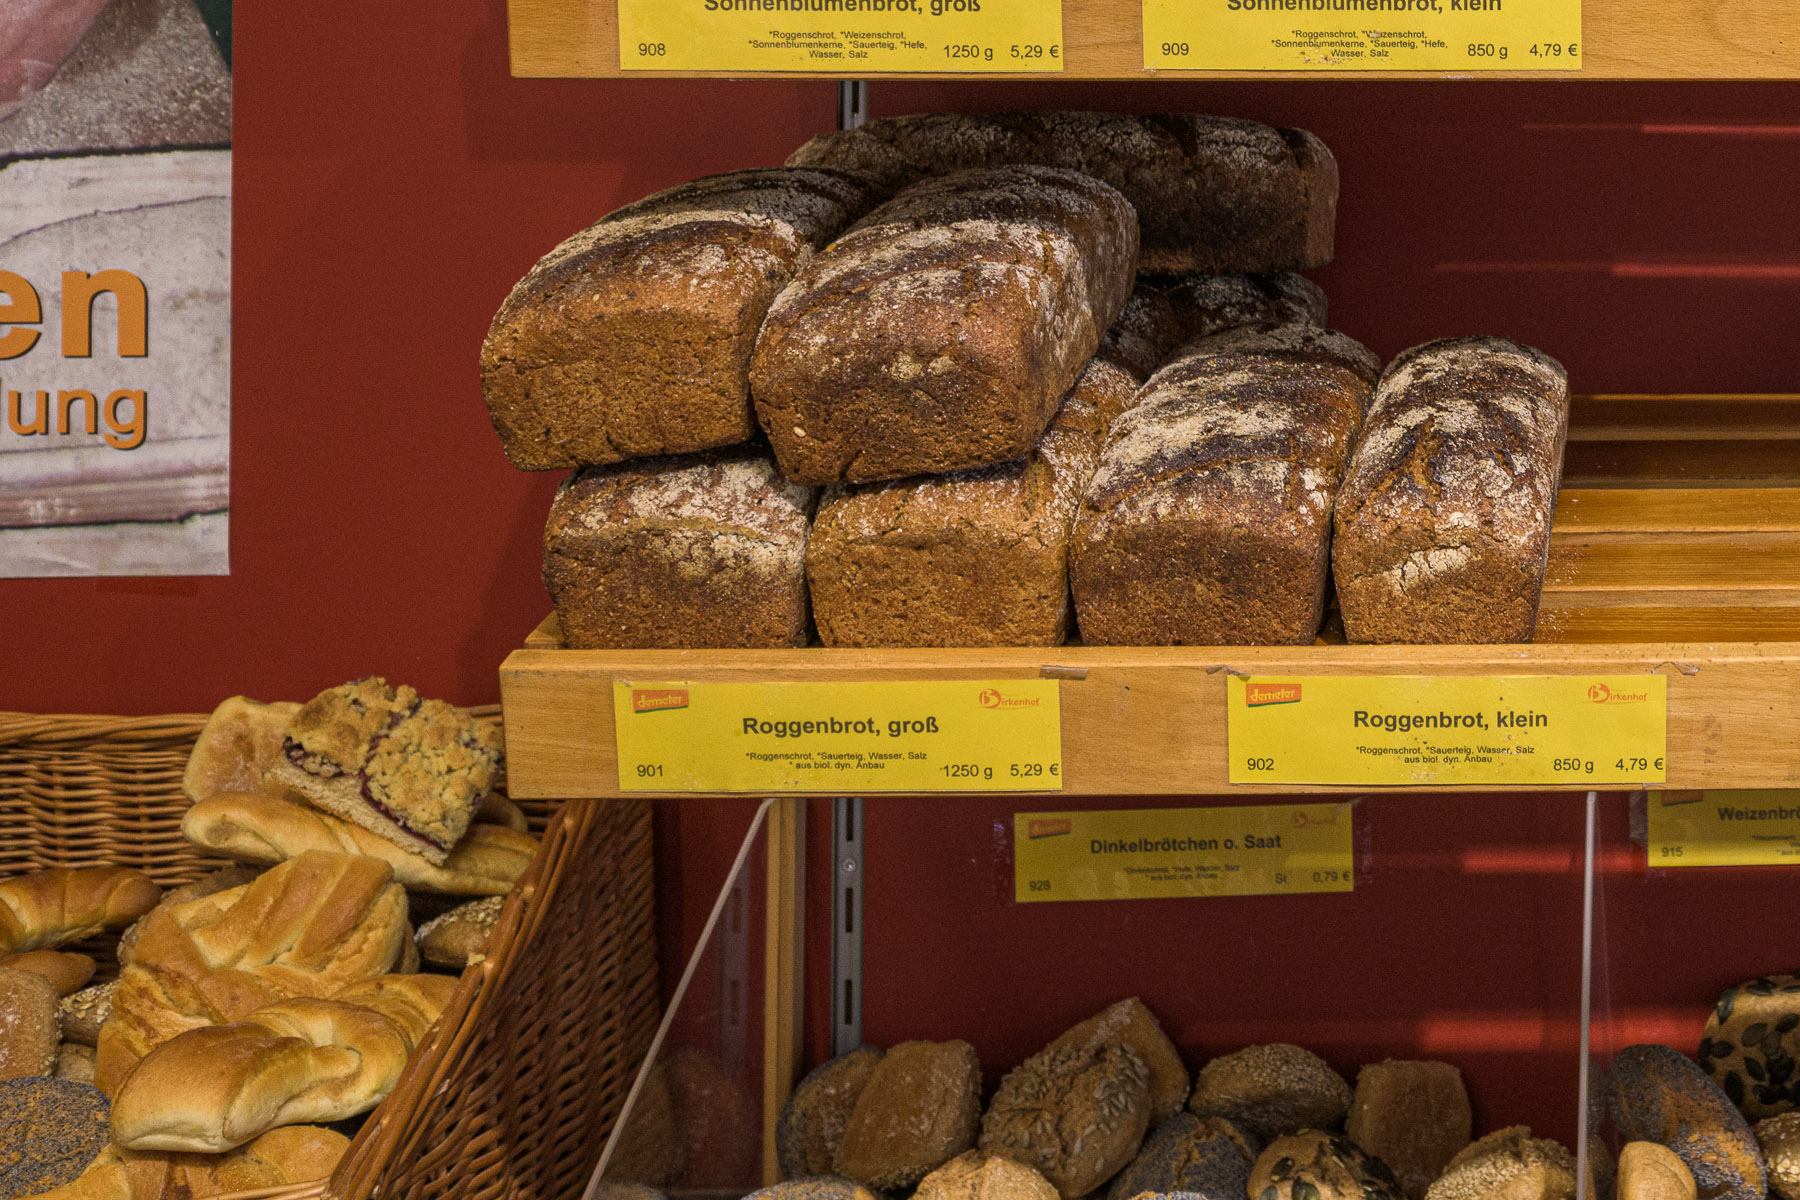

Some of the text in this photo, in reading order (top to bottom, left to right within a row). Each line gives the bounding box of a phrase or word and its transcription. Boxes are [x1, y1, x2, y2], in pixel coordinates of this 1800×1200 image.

[639, 43, 666, 56] 908
[809, 48, 845, 61] Wasser,
[944, 45, 993, 61] 1250 g
[1011, 45, 1059, 59] 5,29 €
[1162, 43, 1189, 56] 909
[1499, 47, 1507, 59] g
[1530, 44, 1577, 58] 4,79 €
[0, 378, 147, 451] ung
[743, 716, 939, 738] Roggenbrot, groß
[1354, 710, 1547, 732] Roggenbrot, klein
[943, 764, 992, 780] 1250 g
[1010, 763, 1059, 778] 5,29 €
[1553, 758, 1593, 774] 850 g
[1616, 758, 1663, 772] 4,79 €
[1090, 834, 1282, 854] Dinkelbrötchen o. Saat
